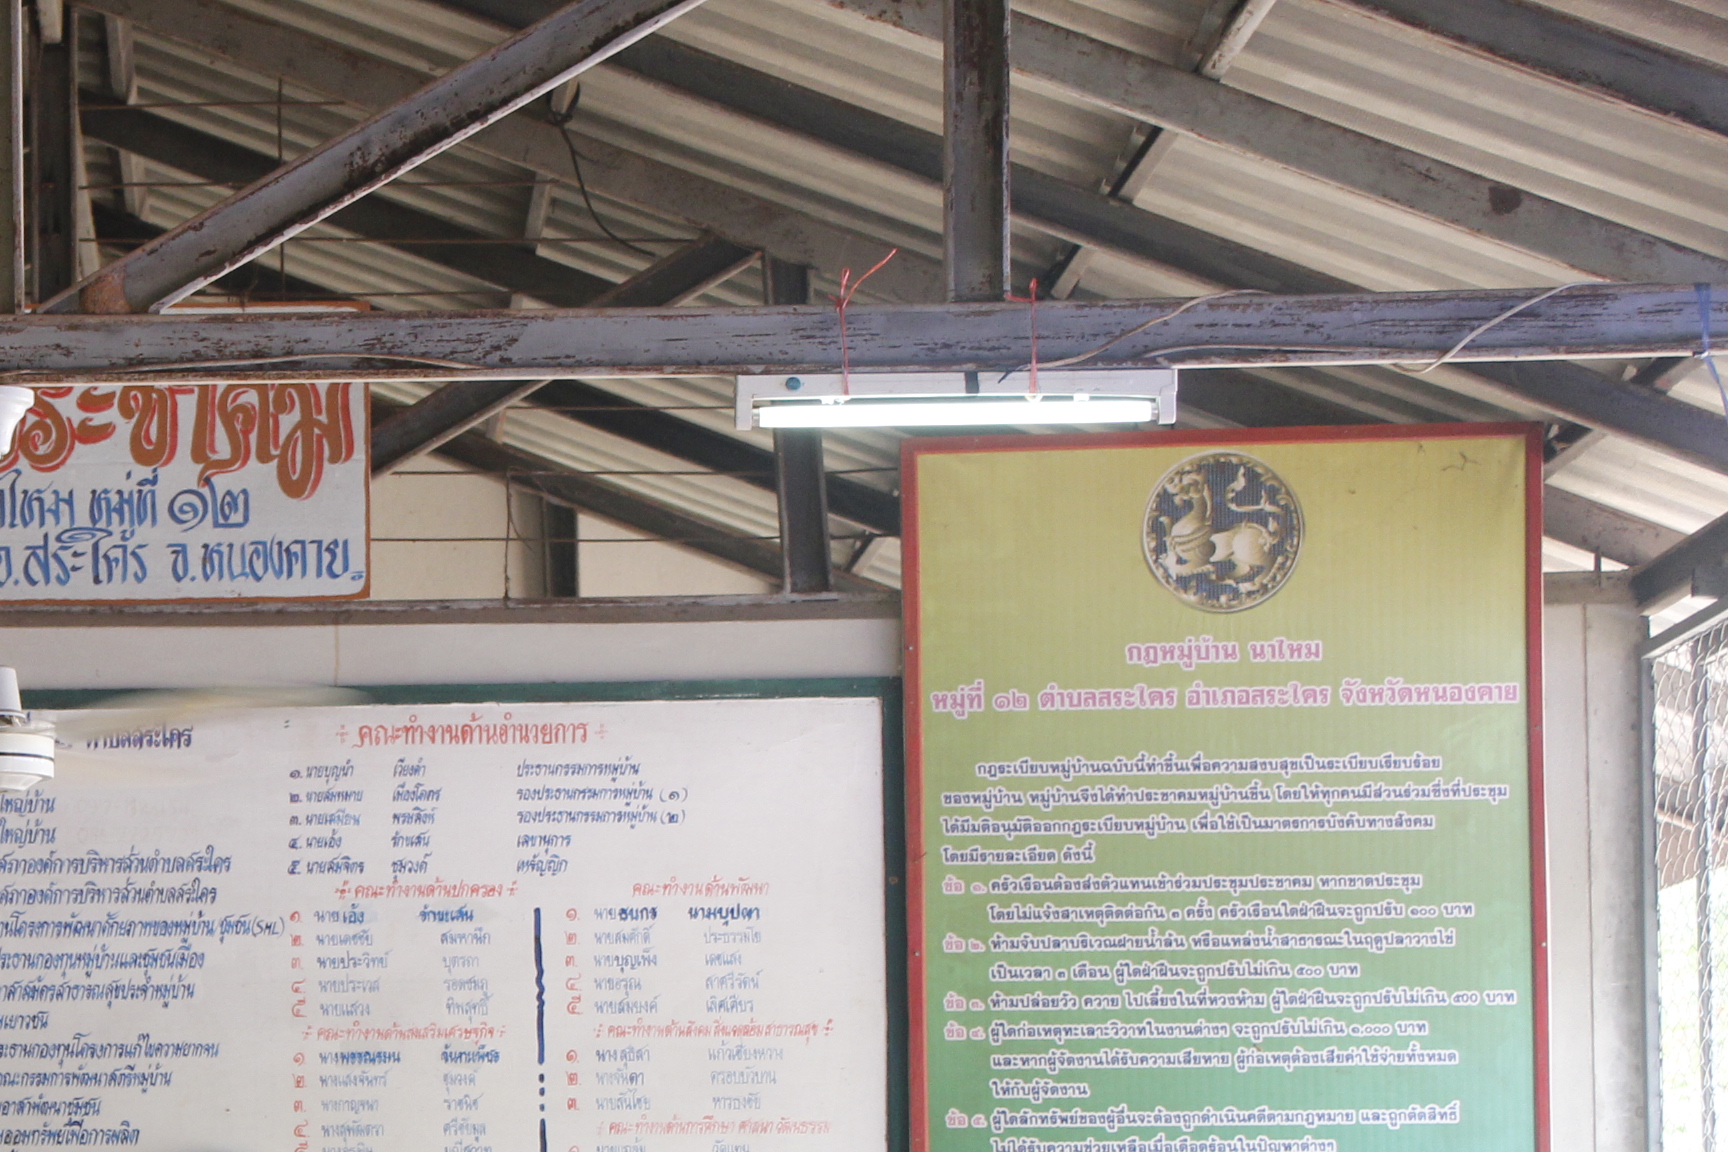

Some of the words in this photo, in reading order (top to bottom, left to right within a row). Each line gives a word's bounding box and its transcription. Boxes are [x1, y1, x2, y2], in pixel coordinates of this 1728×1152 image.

[167, 477, 251, 531] ๑๒
[1249, 640, 1322, 662] นาไหม
[932, 681, 984, 717] หมู่ที่
[993, 691, 1029, 711] ๑๒
[1040, 686, 1177, 711] ตำบลสระใคร
[1186, 683, 1330, 710] อำเภอสระใคร
[1339, 680, 1519, 706] จังหวัดหนองคาย
[1061, 841, 1096, 864] ดังนี้
[943, 876, 964, 893] ข้อ
[1185, 898, 1213, 919] ครั้ง
[1410, 908, 1437, 918] ๑๐๐
[1443, 902, 1474, 917] บาท
[943, 935, 964, 952] ข้อ
[990, 963, 1051, 980] เป็นเวลา
[1072, 961, 1110, 979] เดือน
[1328, 963, 1360, 977] บาท
[944, 993, 965, 1010] ข้อ
[990, 991, 1077, 1010] ห้ามปล่อยวัว
[1083, 995, 1120, 1009] ควาย
[1485, 989, 1515, 1005] บาท
[945, 1022, 965, 1039] ข้อ
[1397, 1020, 1428, 1035] บาท
[946, 1110, 967, 1128] ข้อ
